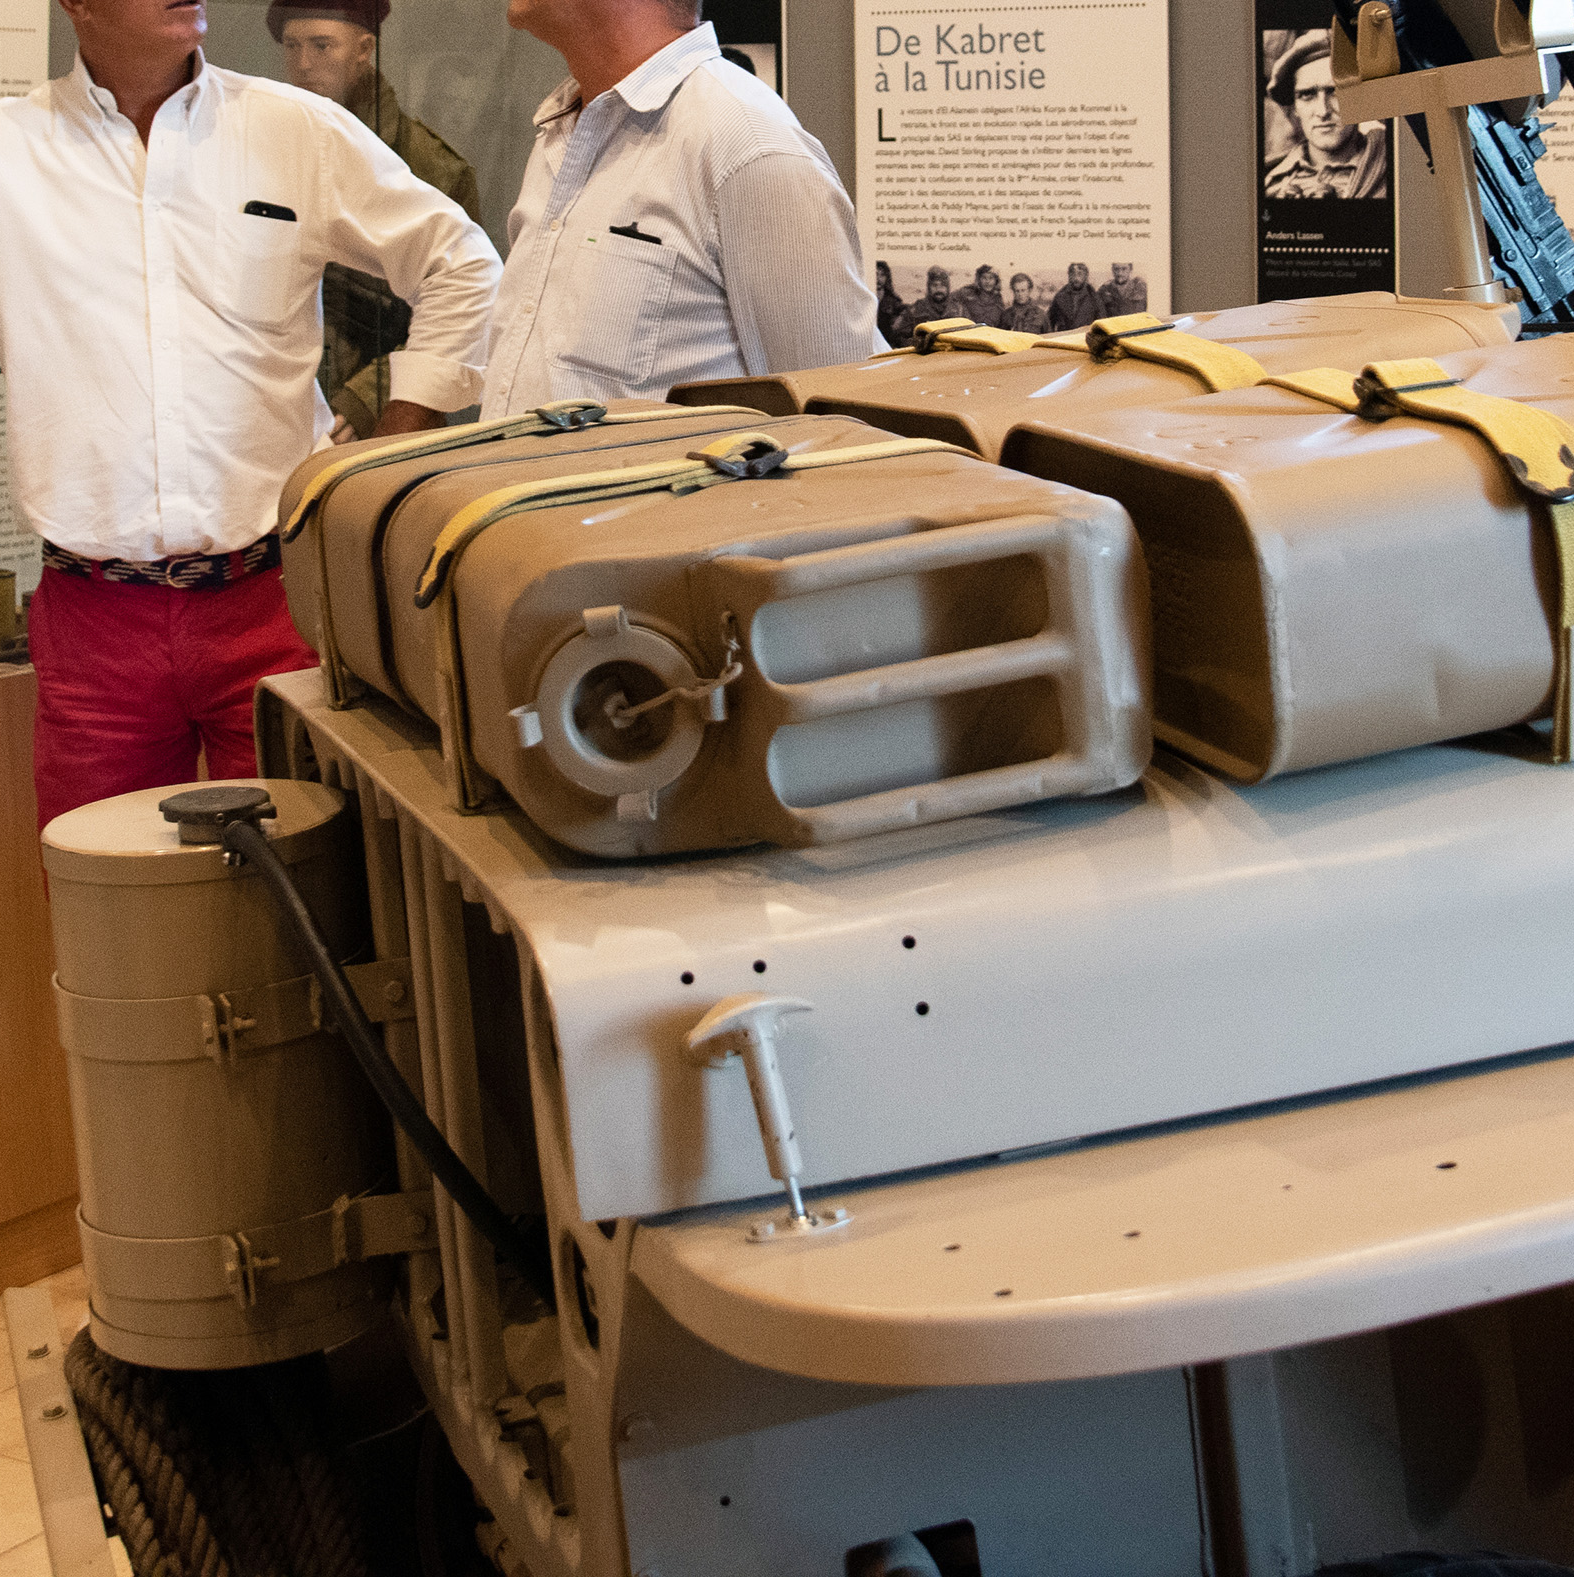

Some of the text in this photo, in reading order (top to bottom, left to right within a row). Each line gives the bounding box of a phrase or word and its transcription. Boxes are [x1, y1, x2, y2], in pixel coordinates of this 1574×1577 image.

[875, 23, 1046, 57] De Kabret
[875, 59, 1046, 93] à la Tunisie
[1265, 231, 1324, 240] Anders Lassen
